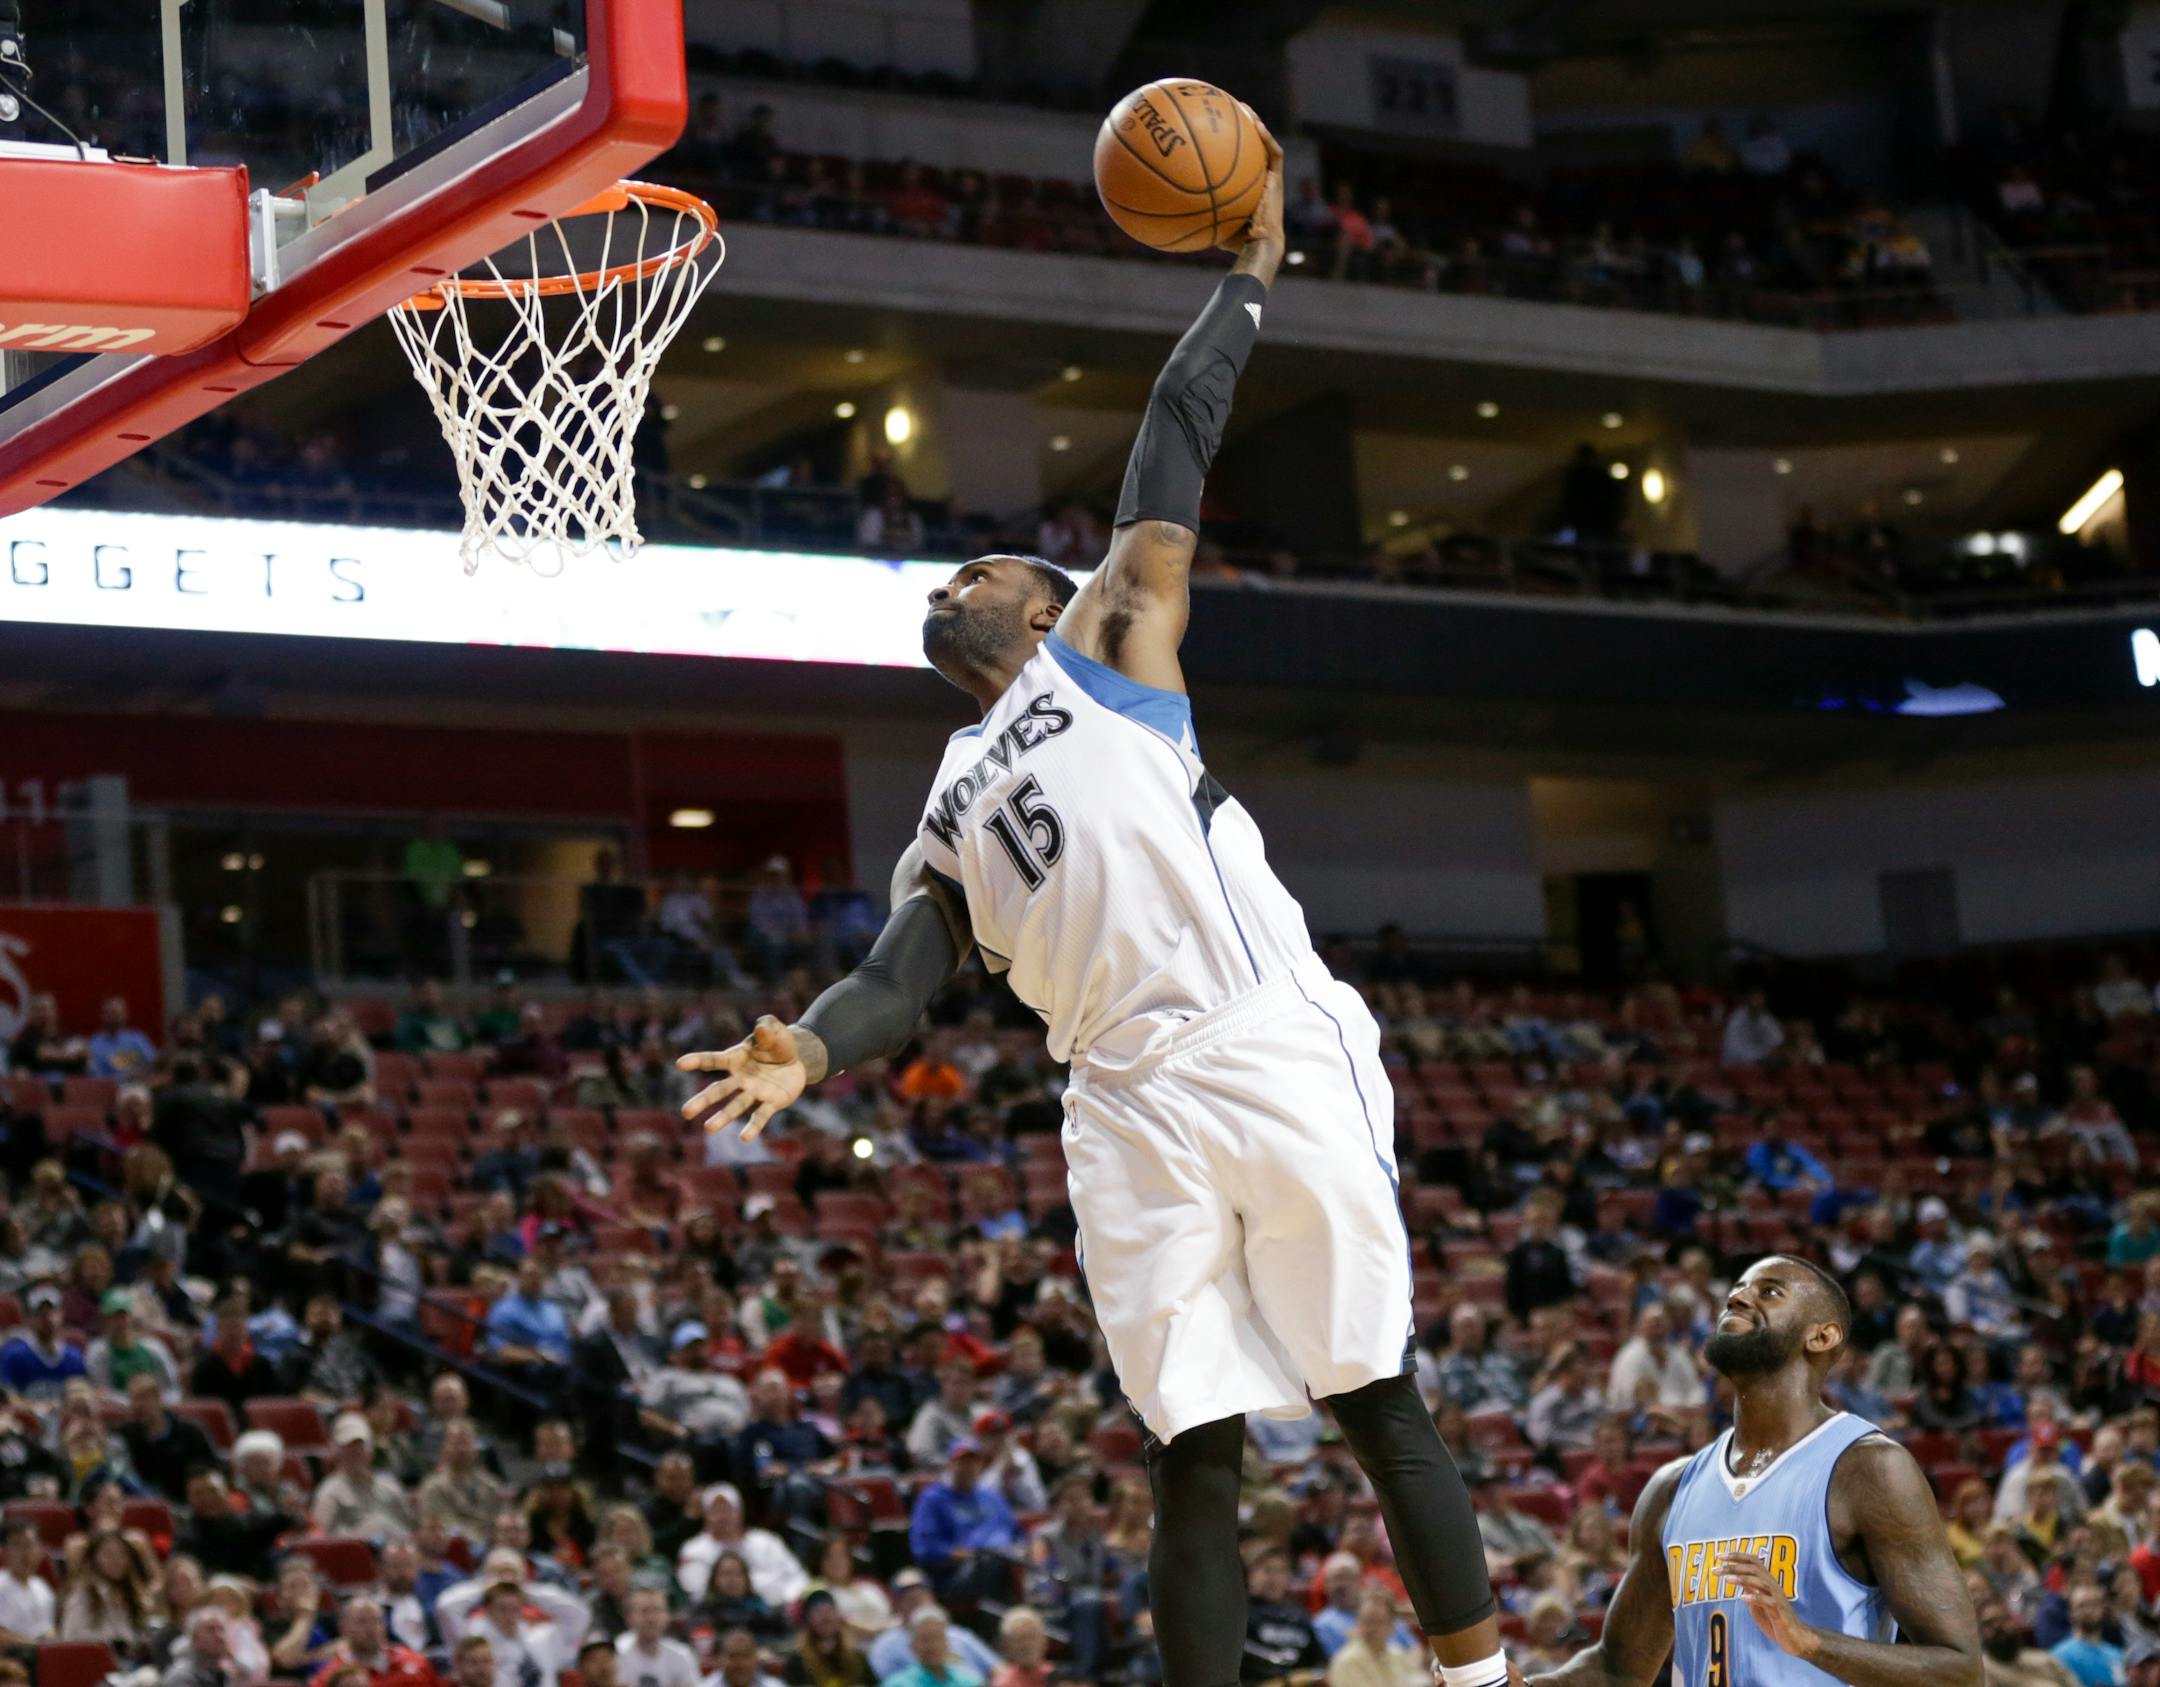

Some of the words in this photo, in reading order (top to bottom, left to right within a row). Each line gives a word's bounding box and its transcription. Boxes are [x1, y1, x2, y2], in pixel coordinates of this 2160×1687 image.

[0, 323, 156, 349] rm
[10, 539, 366, 602] GGETS
[922, 690, 1073, 858] WOLVES
[982, 772, 1066, 893] 15
[1707, 1610, 1730, 1687] 9
